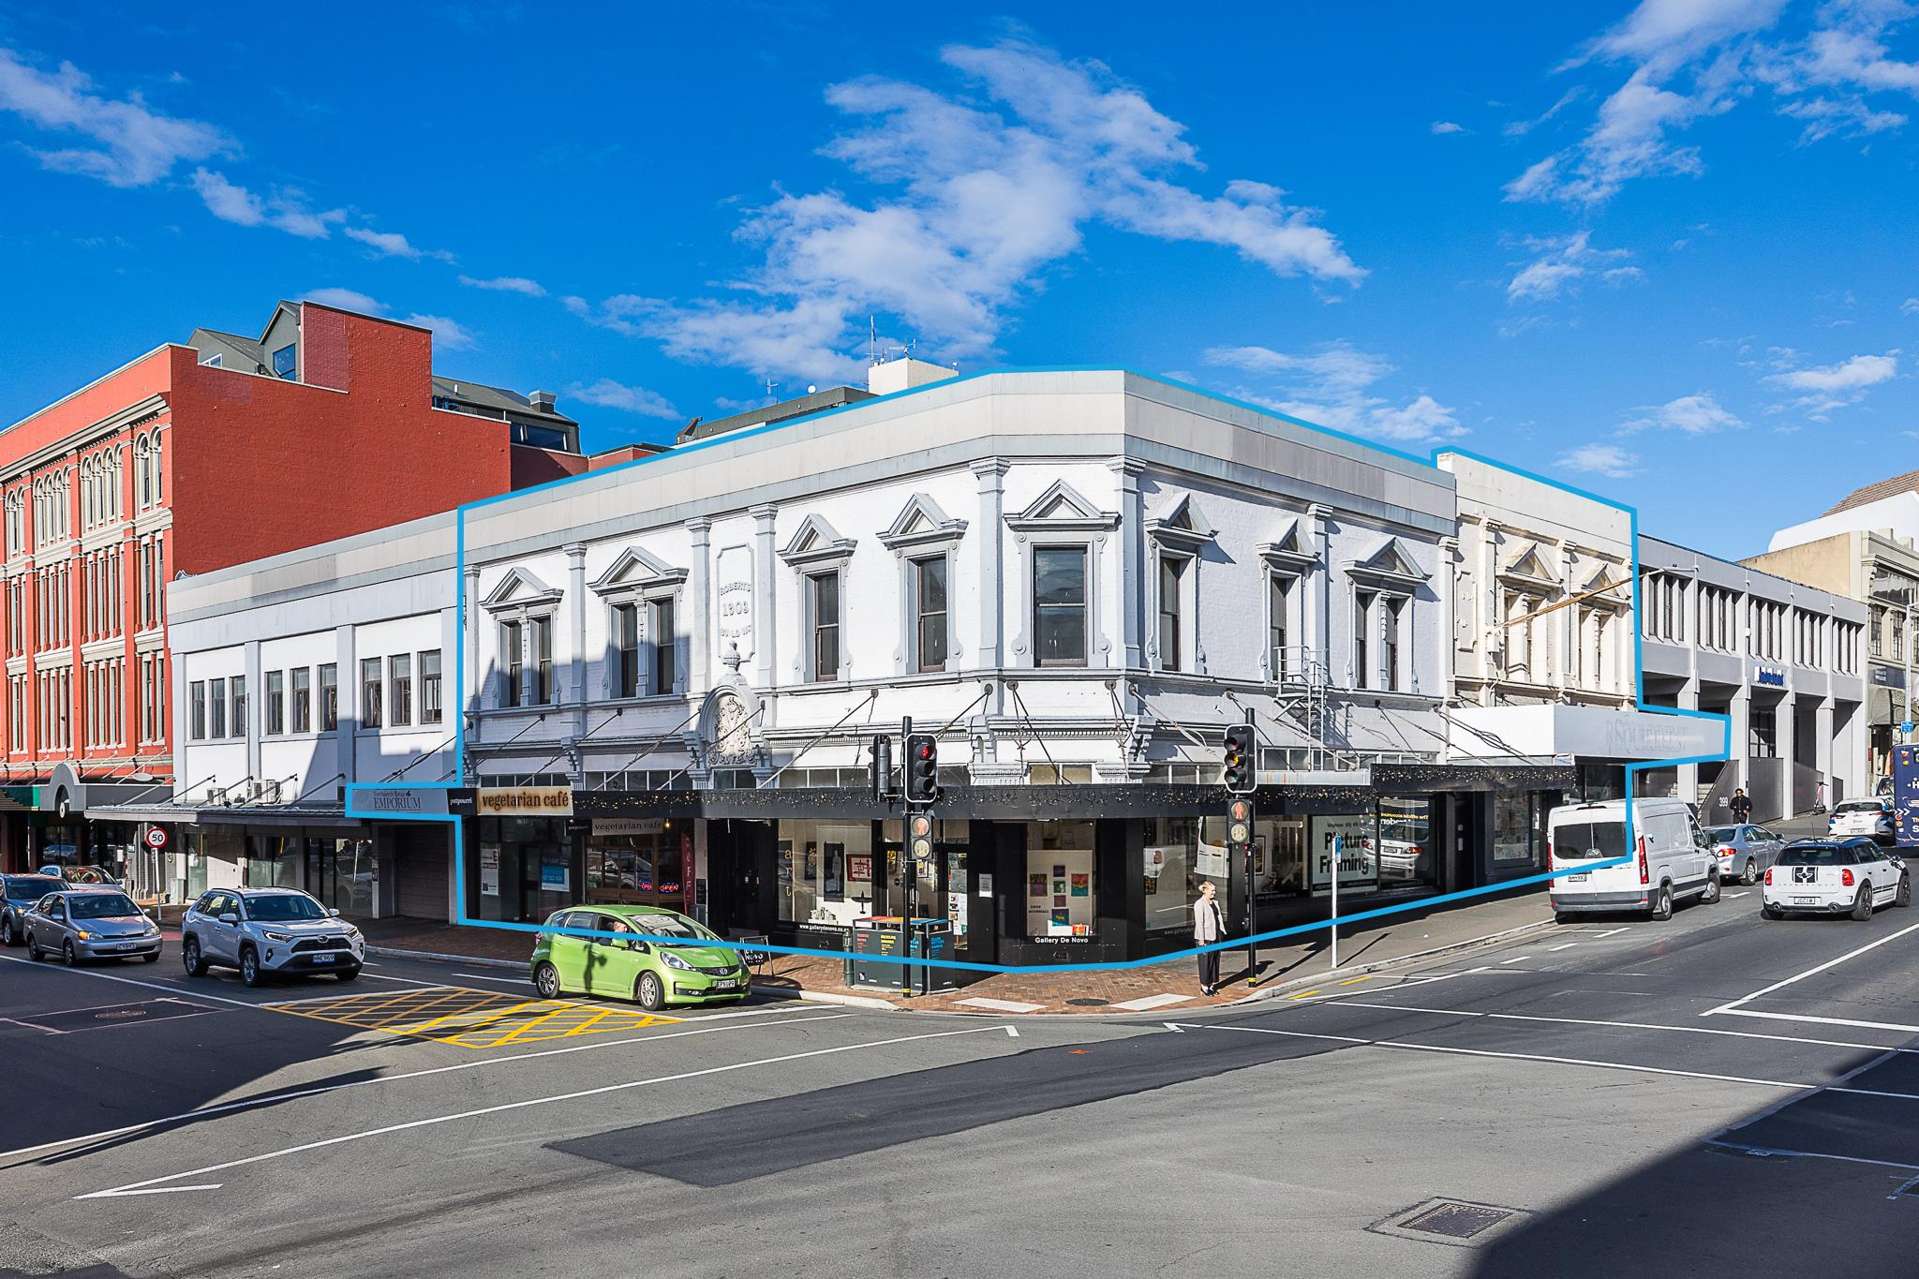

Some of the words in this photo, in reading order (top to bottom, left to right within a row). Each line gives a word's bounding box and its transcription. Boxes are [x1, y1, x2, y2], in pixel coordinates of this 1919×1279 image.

[482, 791, 541, 811] vegetarian
[543, 790, 569, 807] café
[152, 834, 164, 843] 50
[1319, 853, 1369, 875] Frming
[1034, 936, 1059, 945] Gallery
[1060, 936, 1070, 944] De
[1071, 936, 1089, 944] Novo
